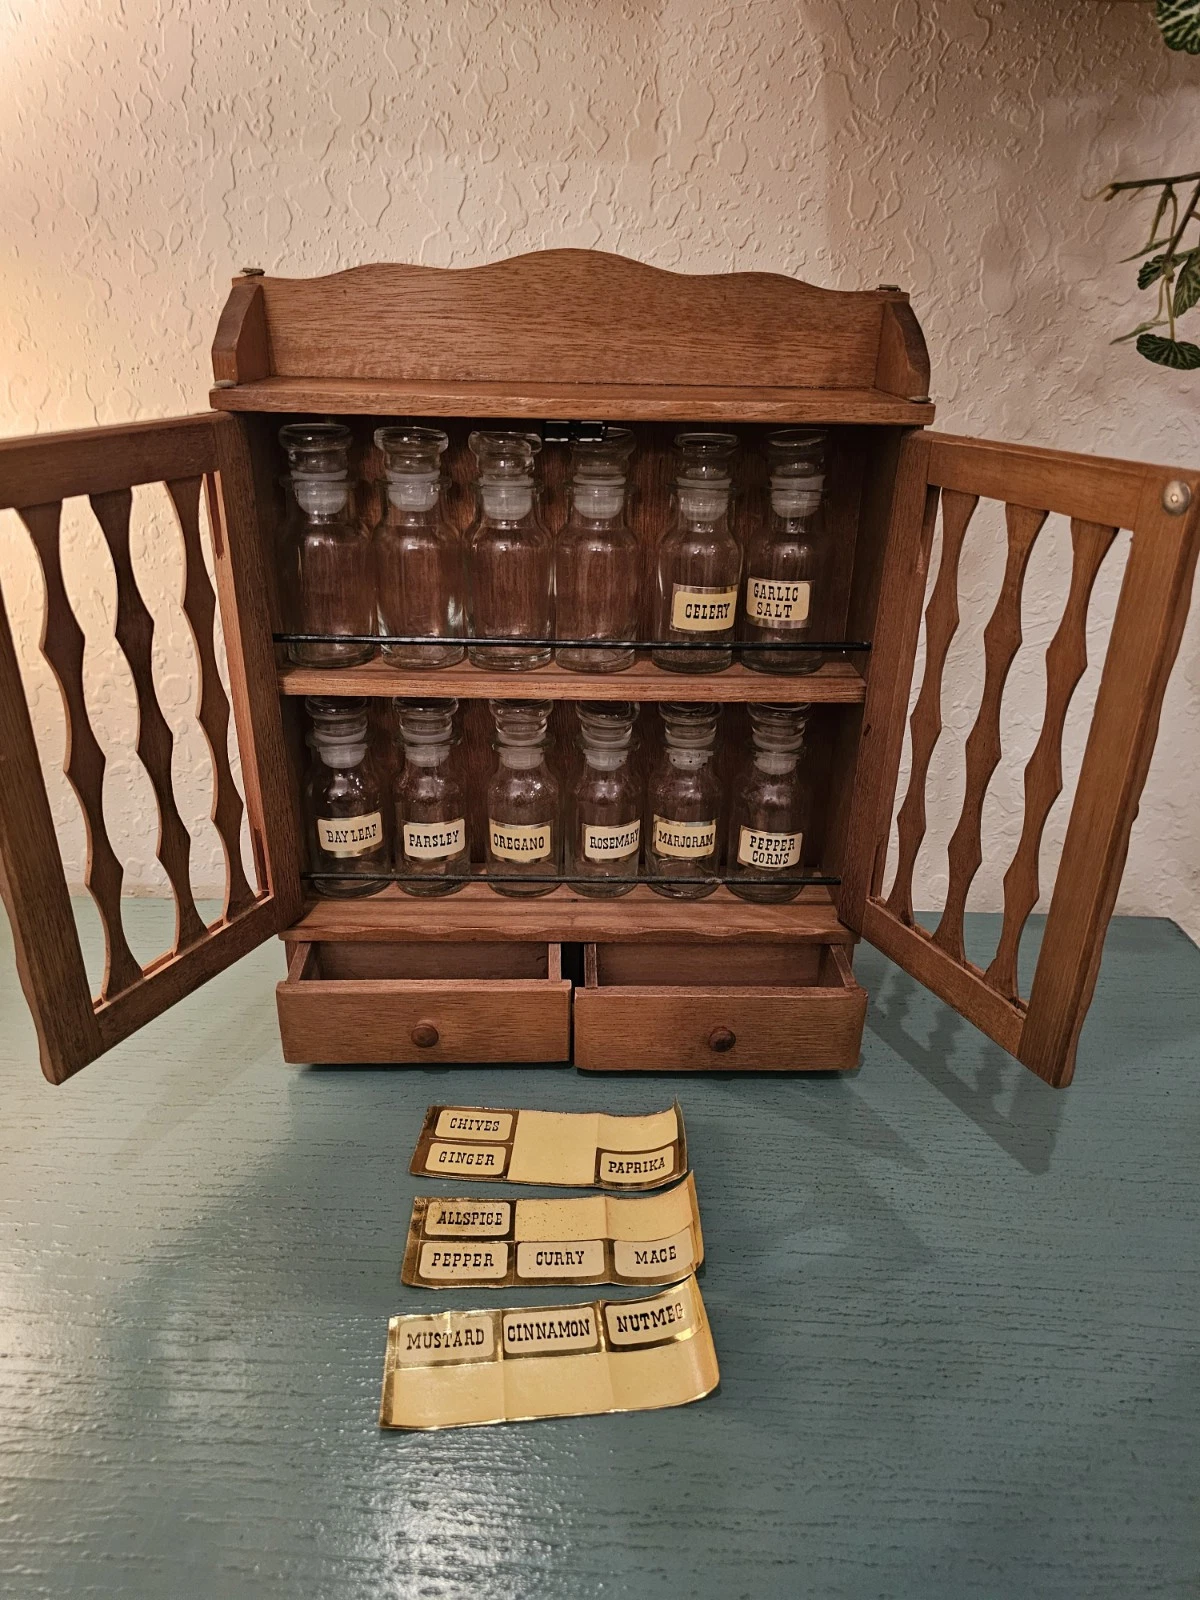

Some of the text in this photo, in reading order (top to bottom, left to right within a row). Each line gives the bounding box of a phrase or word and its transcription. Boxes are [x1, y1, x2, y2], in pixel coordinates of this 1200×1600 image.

[753, 583, 799, 602] GARLIC
[685, 603, 730, 619] CELERY
[756, 602, 793, 618] SALT
[409, 830, 459, 848] PARSLEY
[493, 833, 545, 851] OREGANO
[589, 829, 639, 850] ROSEMARY
[658, 831, 714, 848] MARJORAM
[750, 836, 795, 851] PEPPER
[752, 851, 790, 865] CORNS
[450, 1117, 500, 1132] CHIVES
[439, 1151, 495, 1166] GINGER
[608, 1157, 666, 1174] PAPRIKA
[436, 1210, 503, 1226] ALLSPICE
[431, 1253, 494, 1267] PEPPER
[536, 1251, 585, 1265] CURRY
[635, 1245, 677, 1265] MACE
[616, 1302, 684, 1333] NUTMEG
[406, 1328, 485, 1350] MUSTARD
[507, 1318, 591, 1343] CINNAMON
